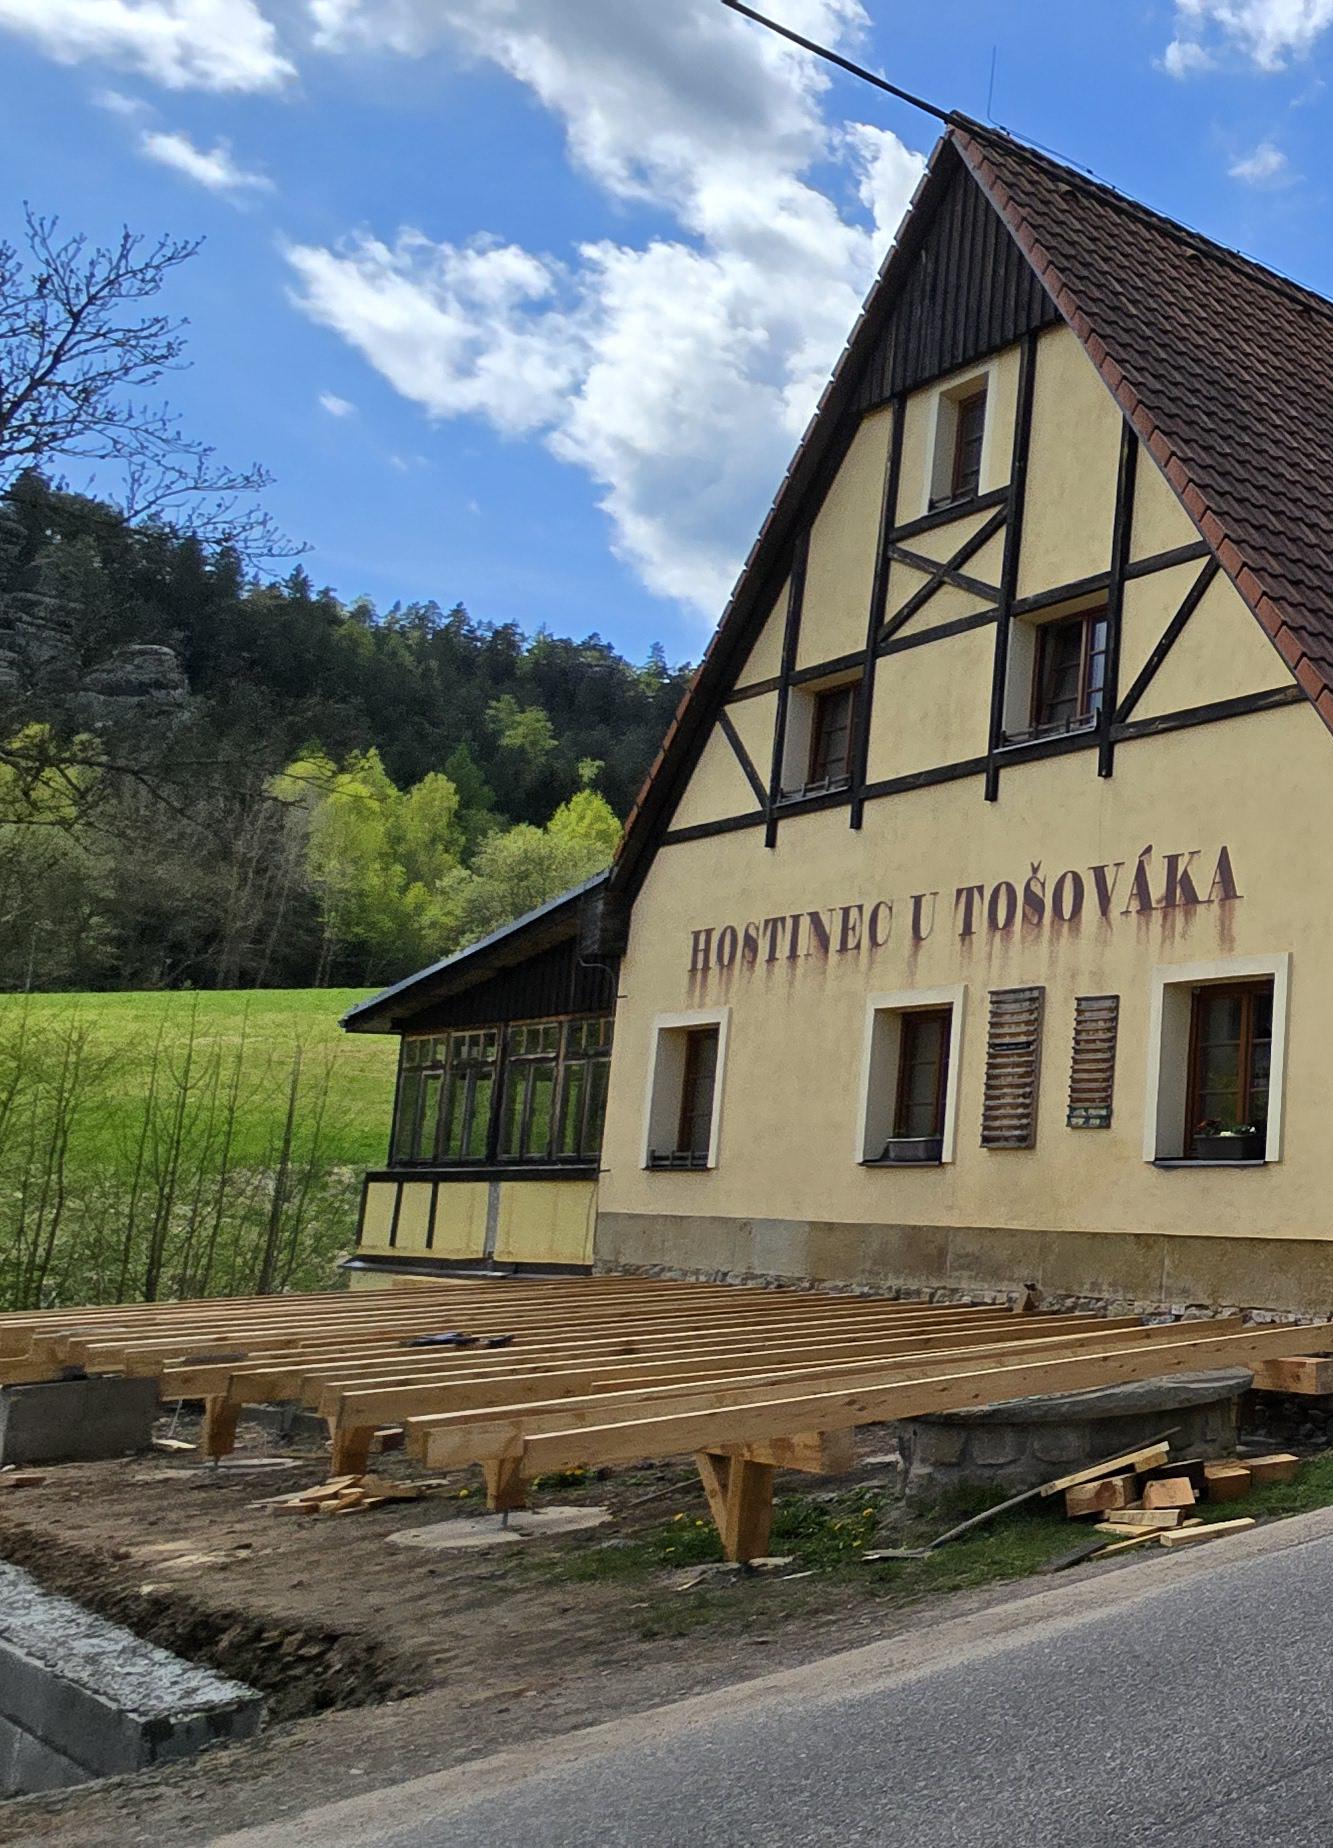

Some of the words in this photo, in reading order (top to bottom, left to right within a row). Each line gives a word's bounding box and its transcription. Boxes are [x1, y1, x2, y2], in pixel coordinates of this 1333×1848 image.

[688, 899, 893, 972] HOSTINEC
[910, 892, 939, 942] U
[954, 844, 1244, 936] TOŠOVÁKA
